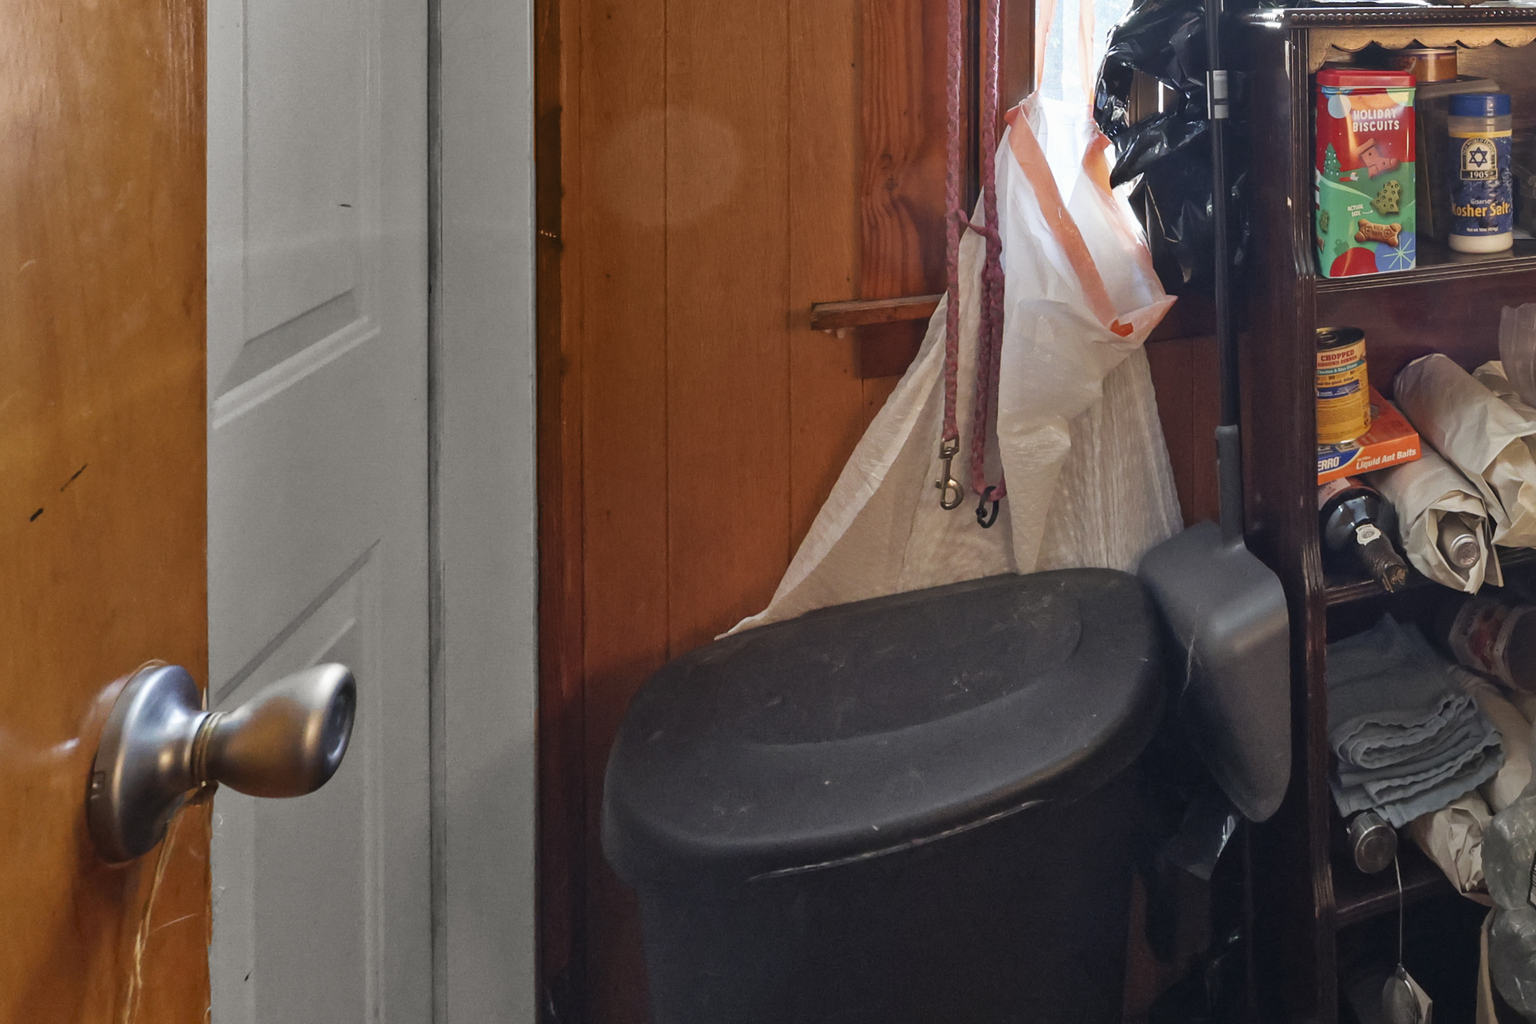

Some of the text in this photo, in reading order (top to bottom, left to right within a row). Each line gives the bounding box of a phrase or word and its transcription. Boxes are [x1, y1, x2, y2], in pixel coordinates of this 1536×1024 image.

[1353, 108, 1396, 121] HOLIDAY
[1353, 120, 1399, 133] BISCUITS
[1469, 171, 1489, 179] 1905
[1452, 200, 1511, 217] Kosher Salt
[1320, 349, 1355, 362] CHOPPED
[1356, 448, 1417, 470] Liquid Ant Baits
